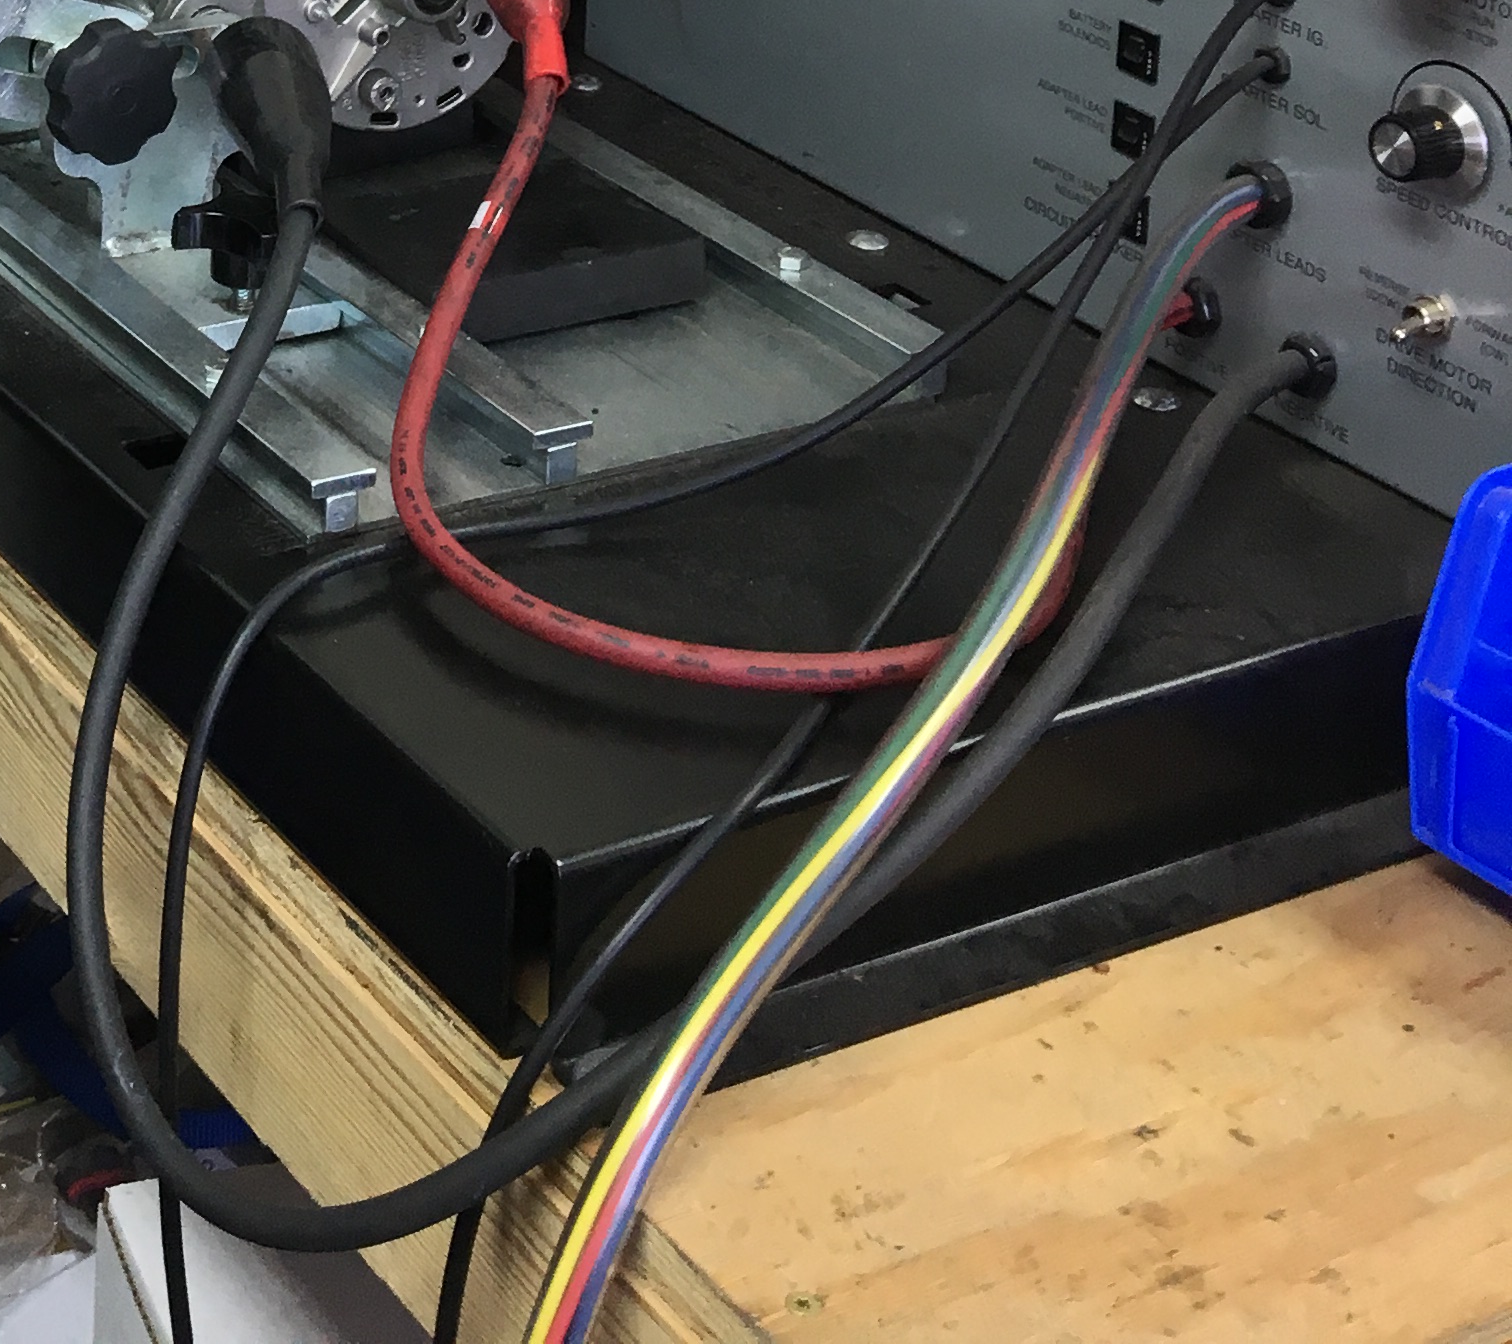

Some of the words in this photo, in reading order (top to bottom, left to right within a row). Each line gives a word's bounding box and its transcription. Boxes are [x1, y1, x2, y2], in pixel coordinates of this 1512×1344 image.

[1375, 176, 1431, 212] SPEED
[1276, 241, 1328, 284] LEADS
[1387, 356, 1477, 413] DIRECTION
[1429, 354, 1493, 395] MOTOR
